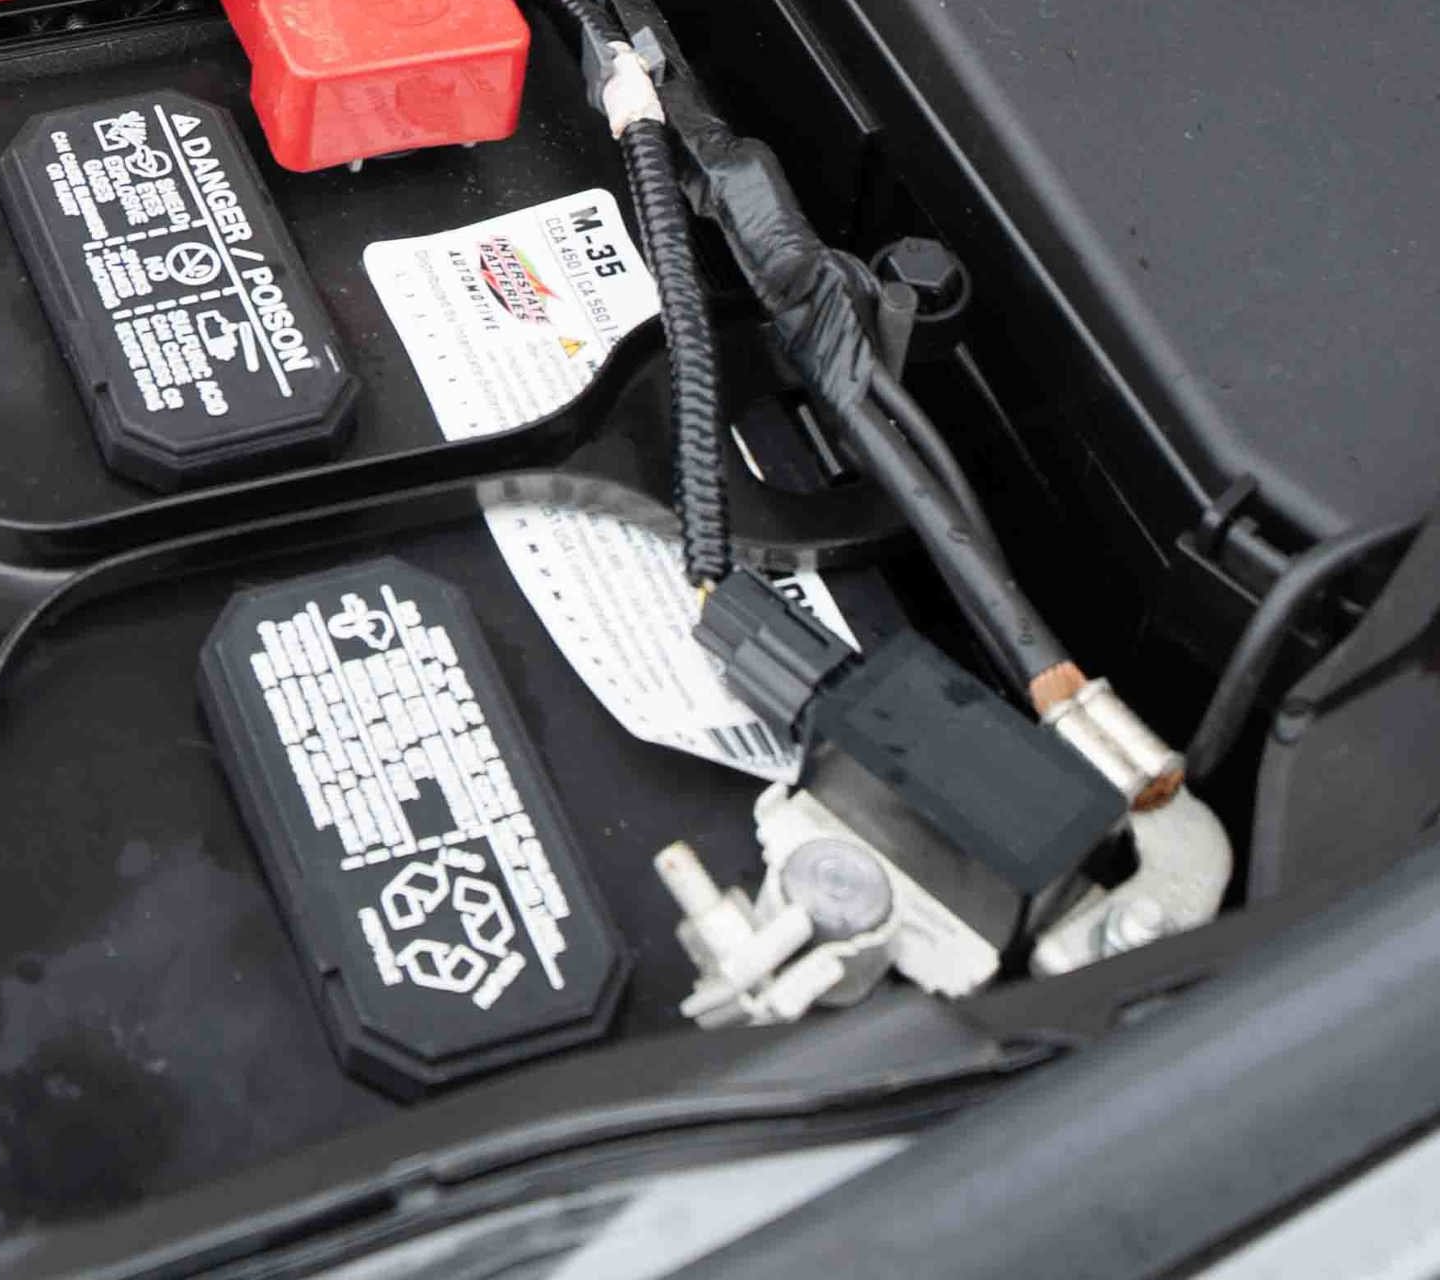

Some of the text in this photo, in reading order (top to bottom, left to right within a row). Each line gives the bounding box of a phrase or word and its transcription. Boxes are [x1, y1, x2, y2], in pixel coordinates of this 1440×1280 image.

[143, 256, 170, 281] NO
[182, 137, 252, 244] DANGER
[241, 268, 314, 372] POISON
[479, 242, 529, 323] BATTERIES
[493, 234, 550, 327] INTERSTATE
[566, 205, 627, 280] M-35
[447, 247, 500, 334] AUTOMOTIVE
